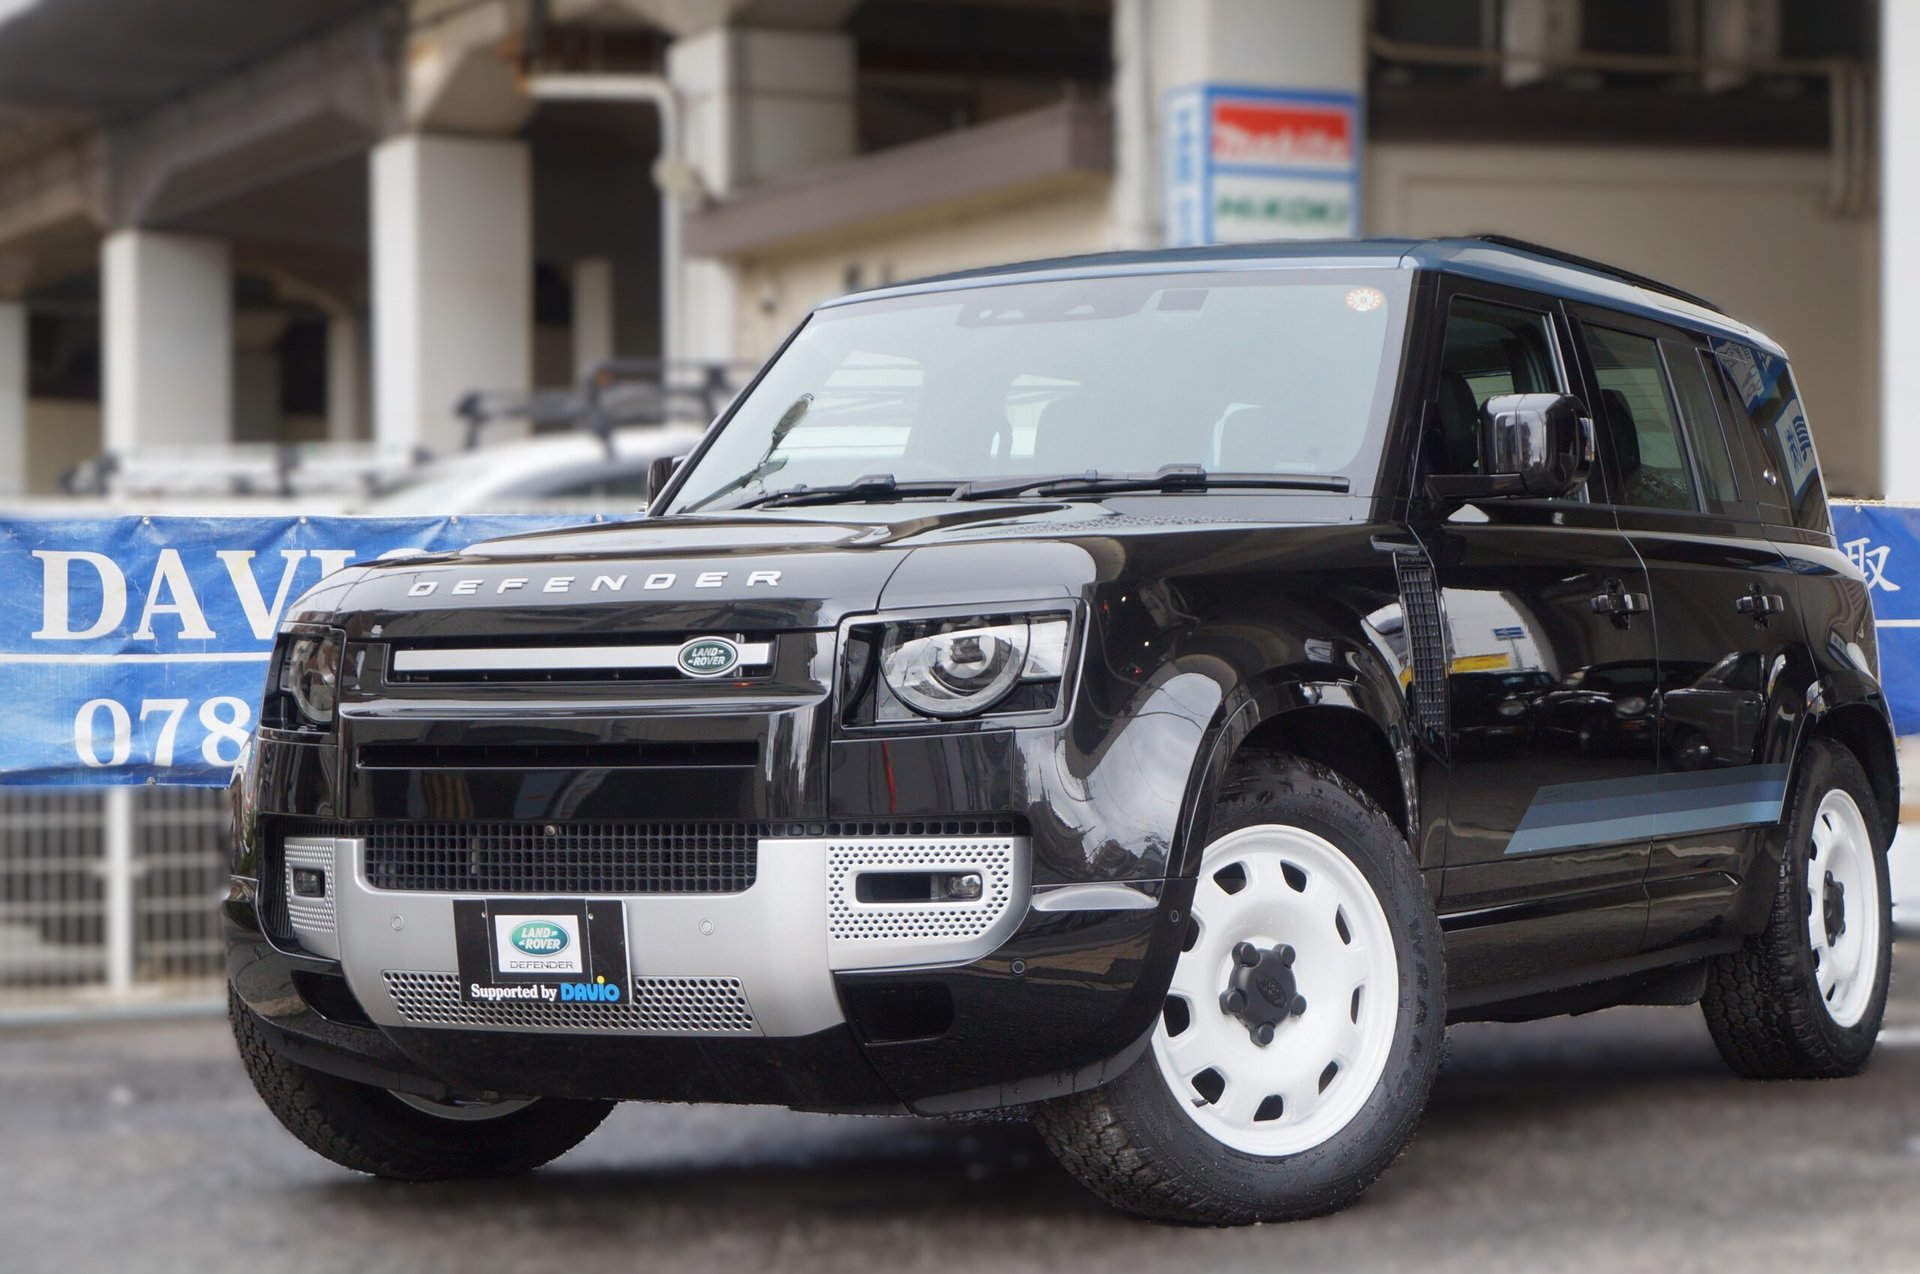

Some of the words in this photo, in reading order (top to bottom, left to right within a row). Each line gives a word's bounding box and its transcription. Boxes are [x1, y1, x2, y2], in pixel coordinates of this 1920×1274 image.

[407, 570, 782, 597] DEFENDER
[31, 548, 429, 641] DAV
[74, 696, 251, 768] 078
[521, 927, 550, 938] LAND
[525, 938, 561, 950] ROVER
[510, 960, 574, 970] DEFENDER
[471, 984, 539, 1000] Supported
[542, 985, 558, 1001] by
